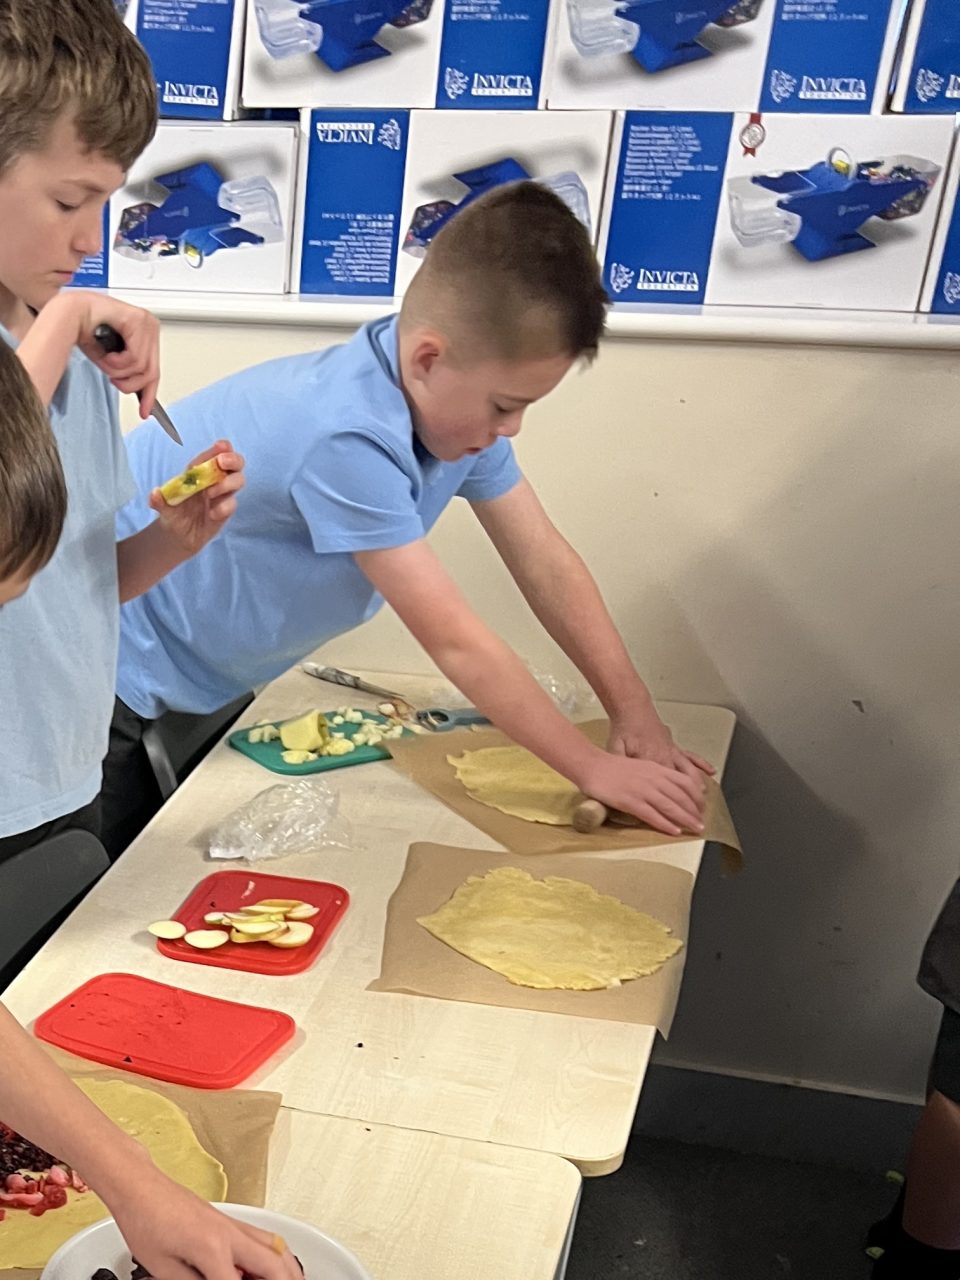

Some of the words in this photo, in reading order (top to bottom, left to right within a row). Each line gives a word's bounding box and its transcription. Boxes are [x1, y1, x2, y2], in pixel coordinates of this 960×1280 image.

[473, 73, 533, 89] INVICTA
[801, 76, 866, 93] INVICTA
[164, 81, 219, 100] INVICTA
[316, 130, 374, 145] INVICTA
[639, 268, 699, 285] INVICTA
